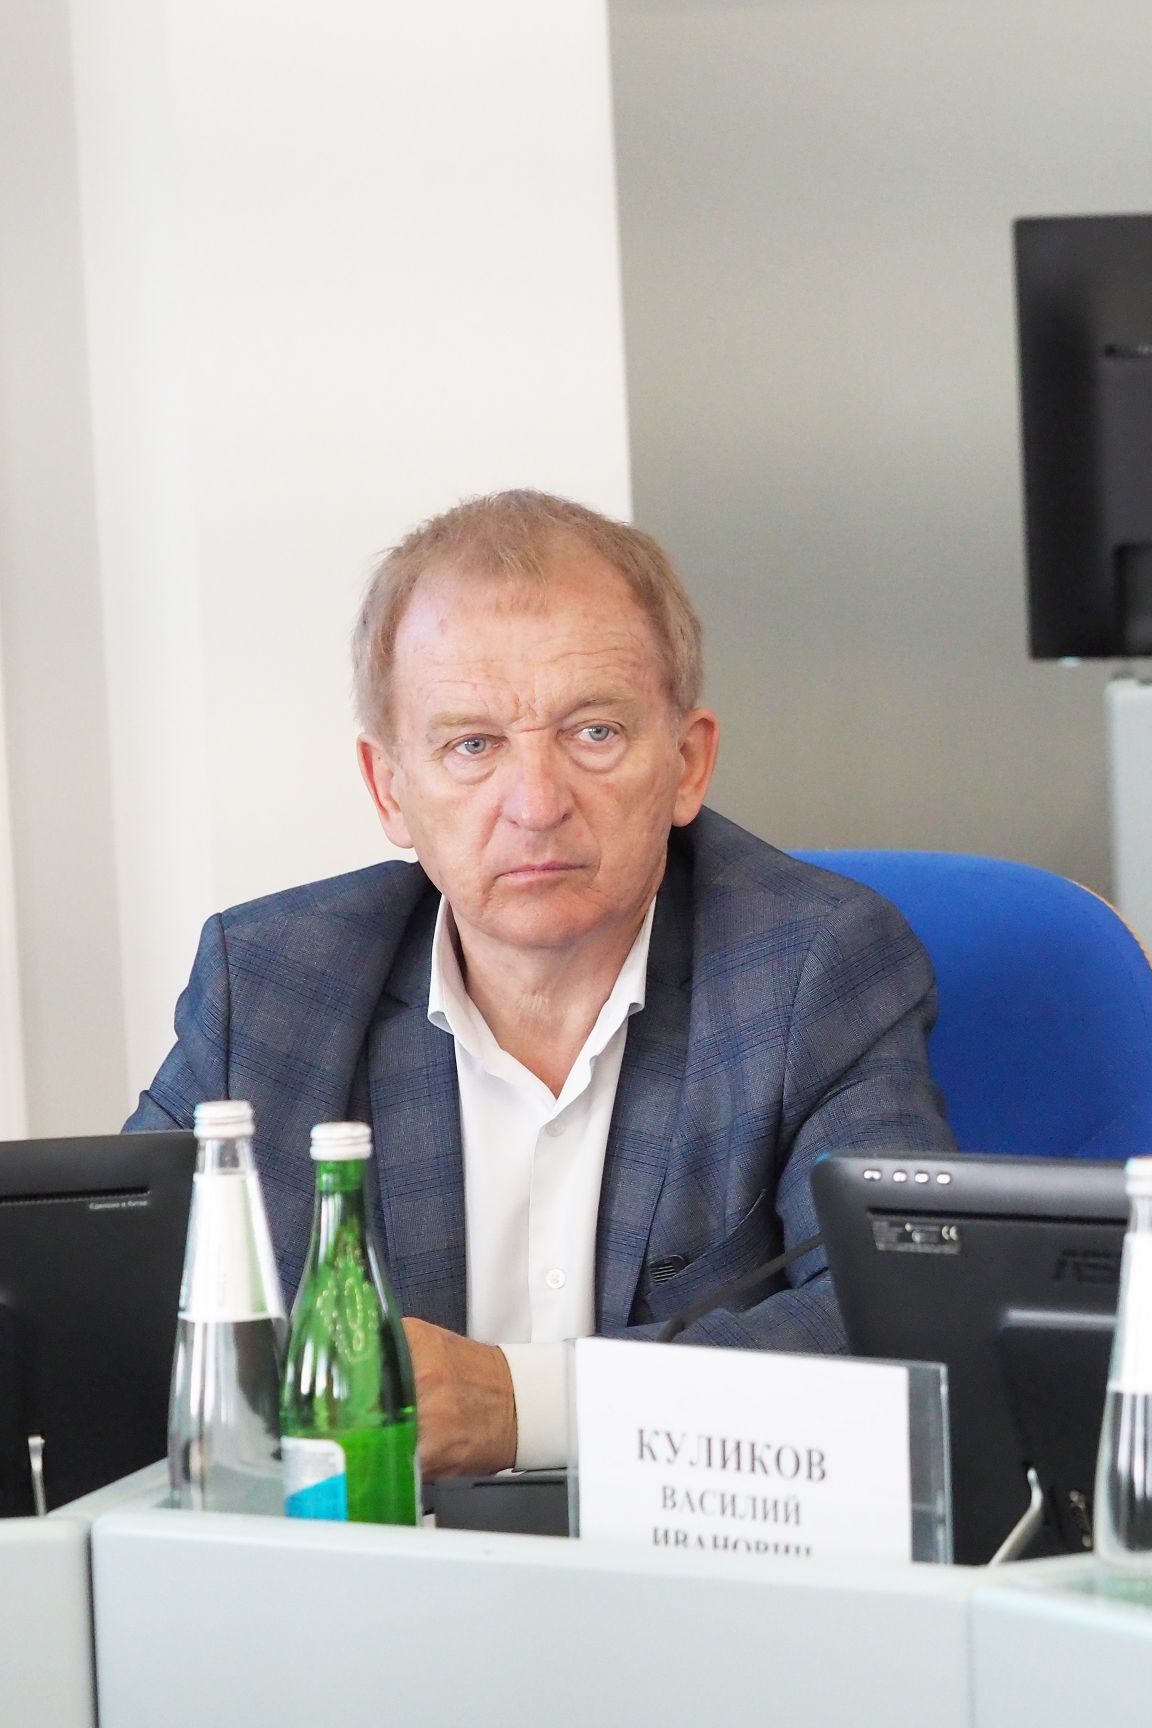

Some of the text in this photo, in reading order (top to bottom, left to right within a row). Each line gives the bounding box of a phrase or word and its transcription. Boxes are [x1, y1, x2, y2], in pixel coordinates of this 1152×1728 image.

[1053, 1249, 1119, 1284] AS
[636, 1428, 827, 1482] КУЛИКОВ
[661, 1485, 802, 1526] ВАСИЛИЙ
